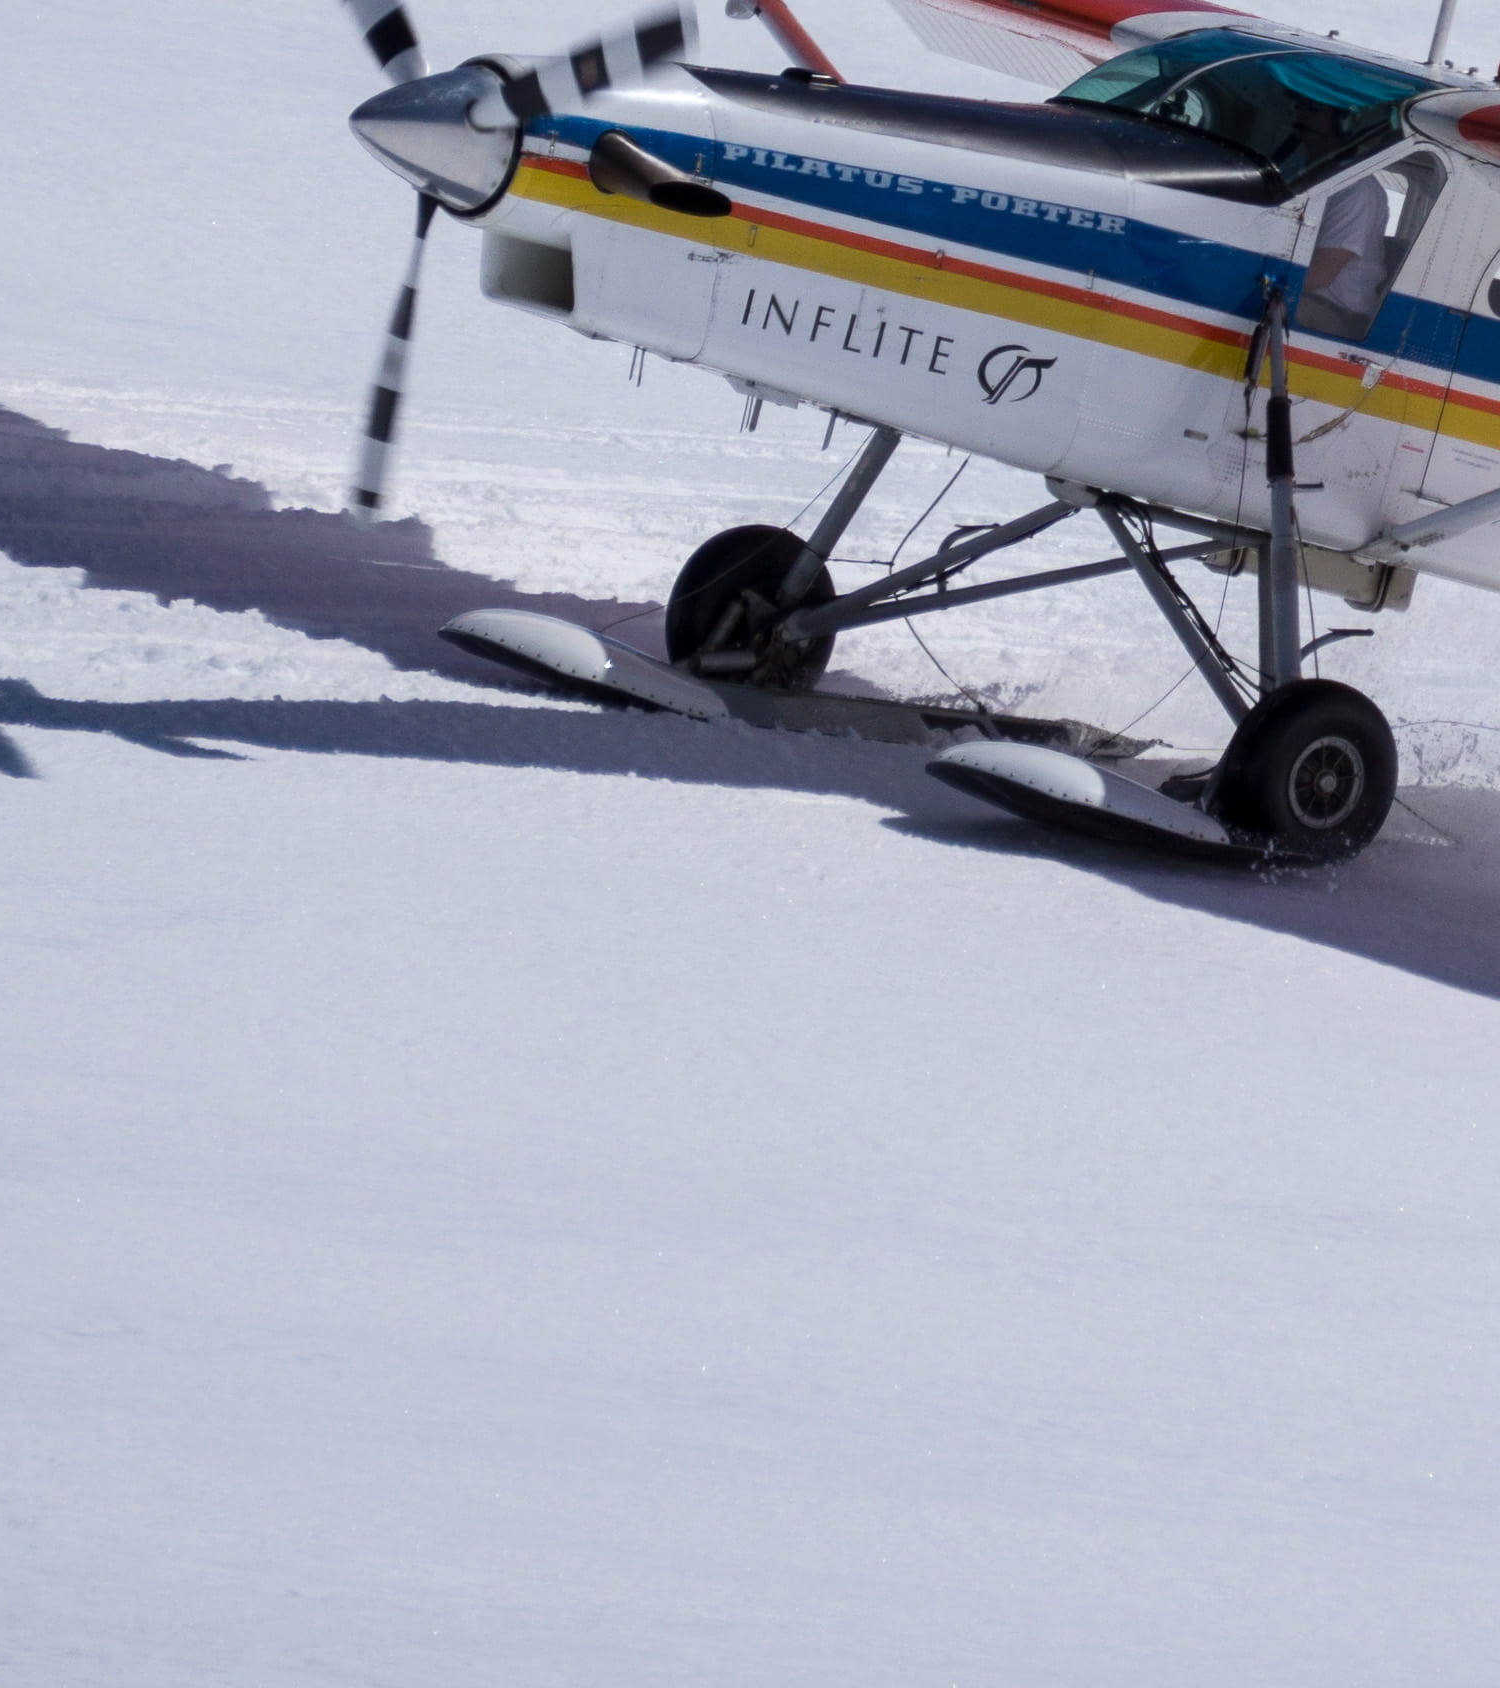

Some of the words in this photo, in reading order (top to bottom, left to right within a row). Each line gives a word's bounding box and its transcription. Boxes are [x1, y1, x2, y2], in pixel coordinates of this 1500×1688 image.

[723, 142, 925, 196] PILATUS
[951, 184, 1126, 235] PORTER
[741, 288, 955, 375] INFLITE
